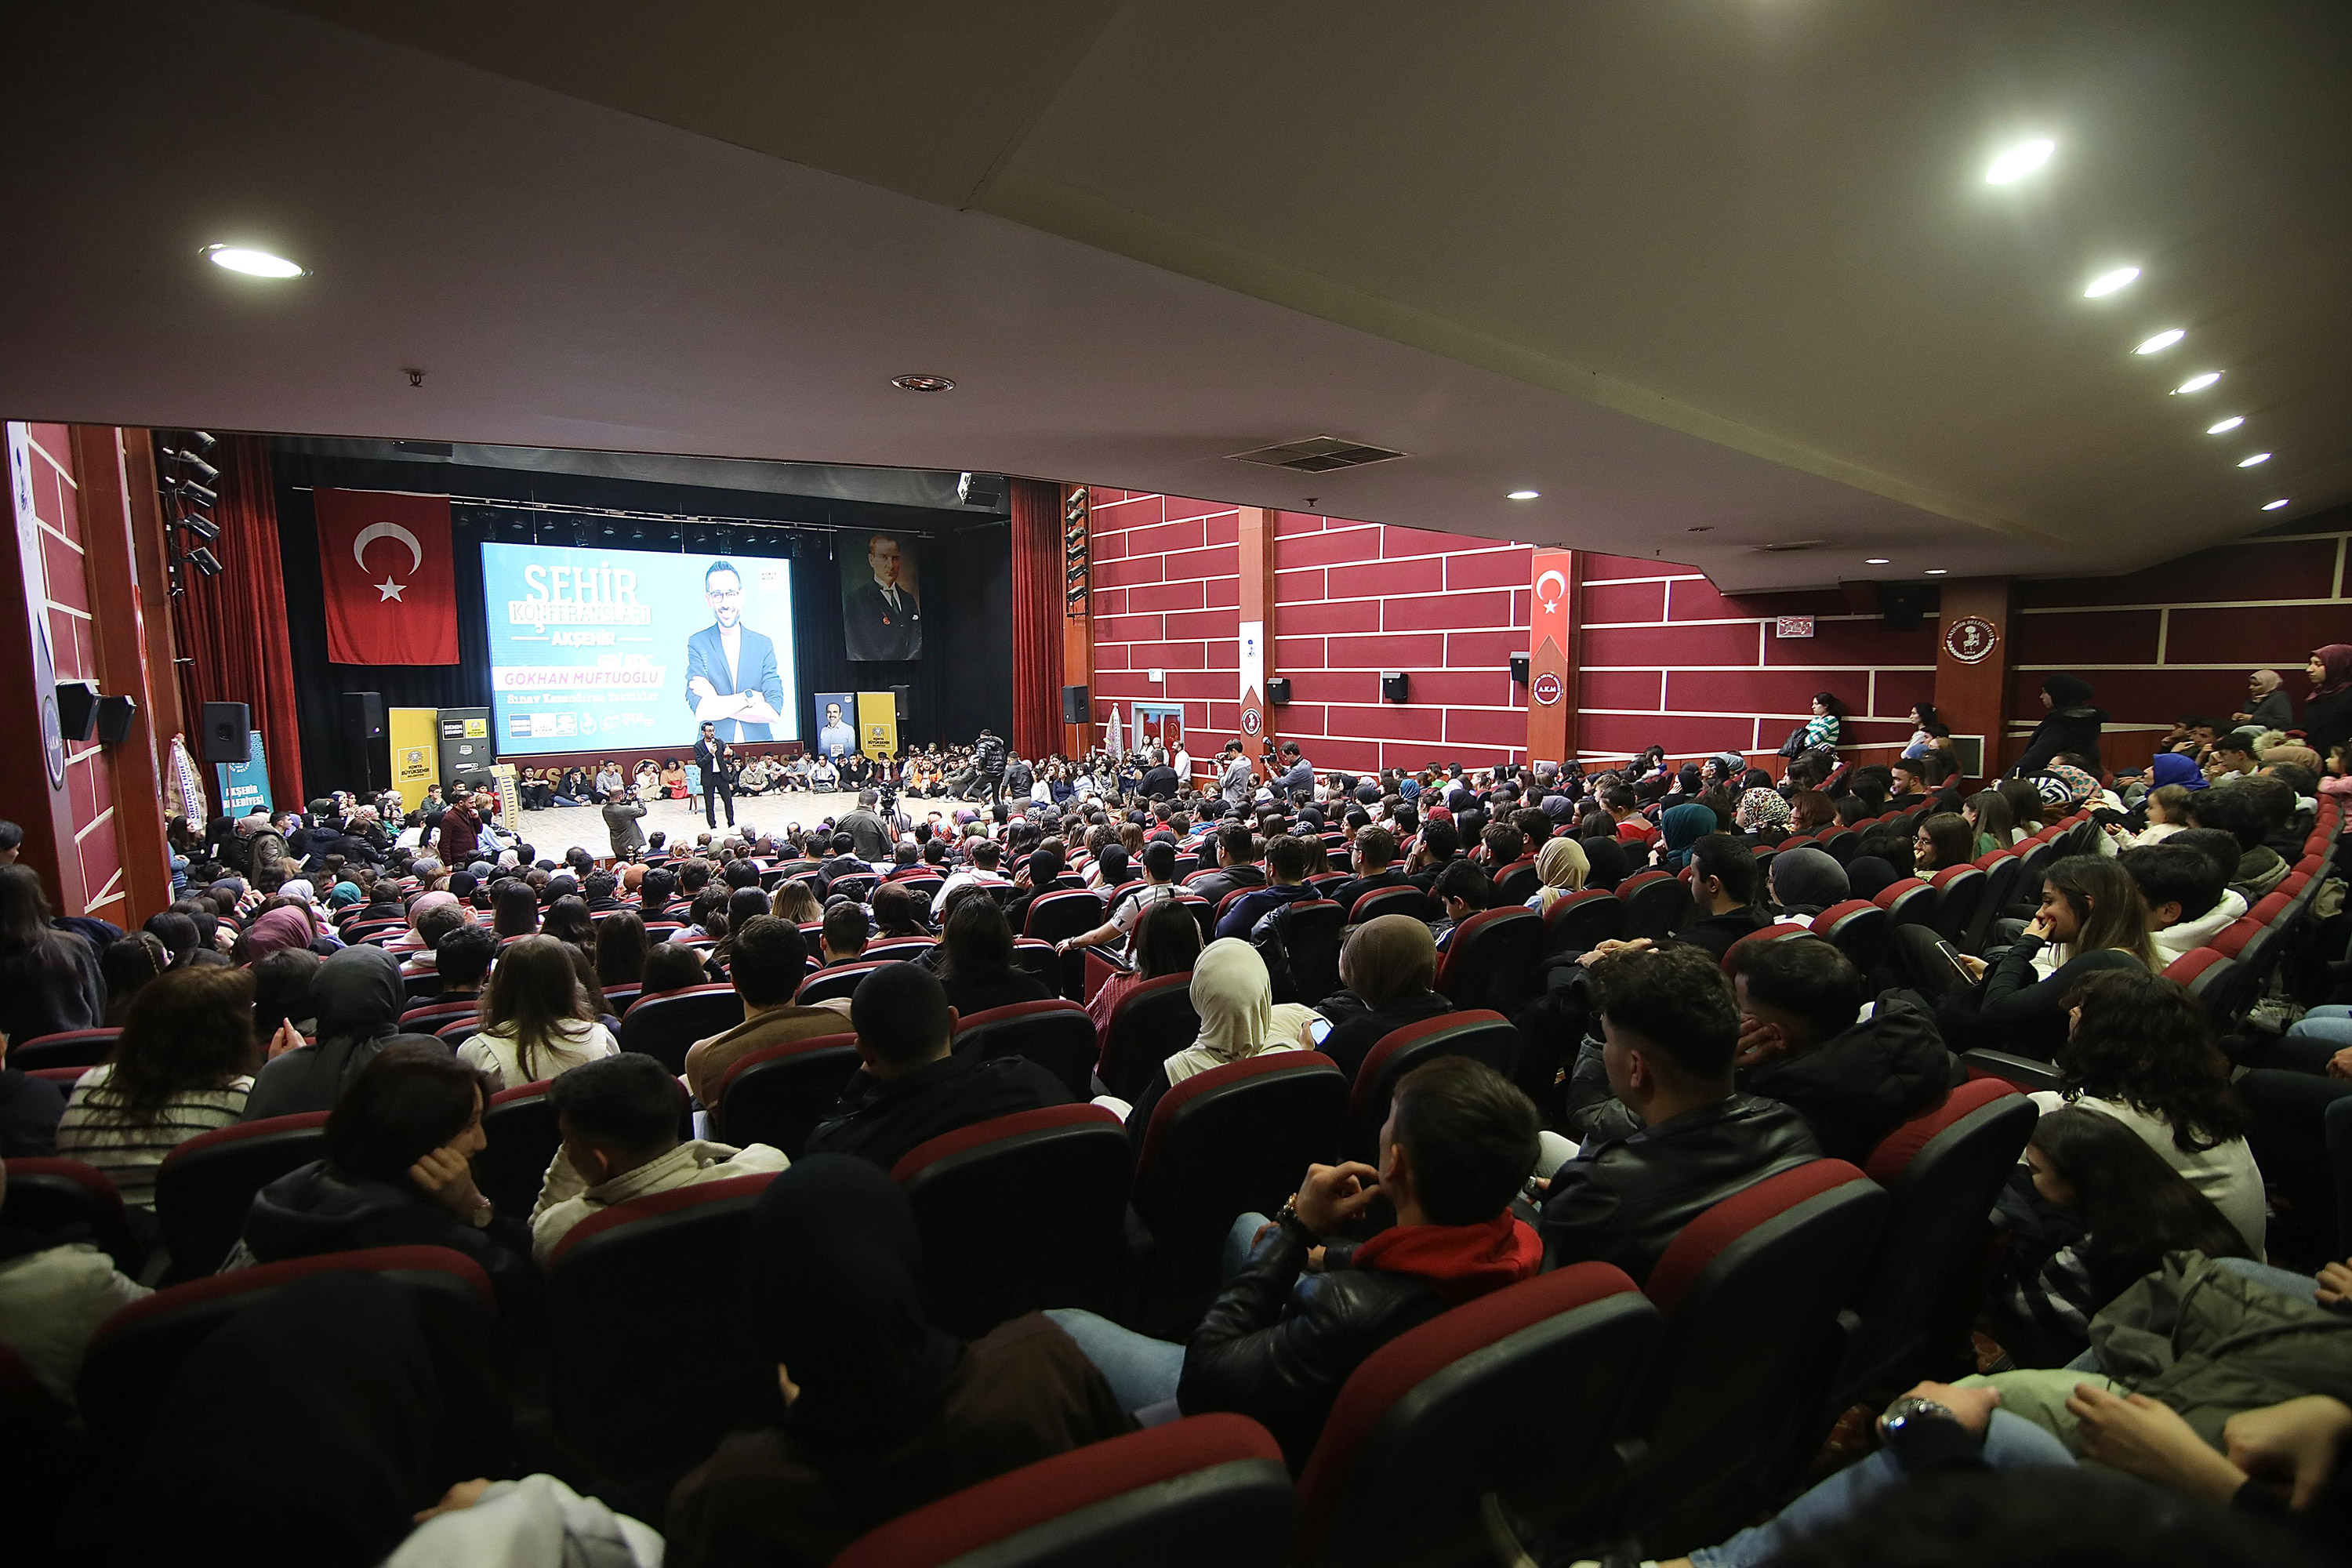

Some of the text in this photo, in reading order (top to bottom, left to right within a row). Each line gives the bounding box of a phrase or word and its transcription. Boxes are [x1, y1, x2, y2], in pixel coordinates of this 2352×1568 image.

[512, 604, 650, 623] KONFERANSLARI
[551, 629, 616, 649] AKŞEHİR
[504, 669, 569, 686] GÖKHAN
[176, 756, 195, 819] ORHAN ERDEM
